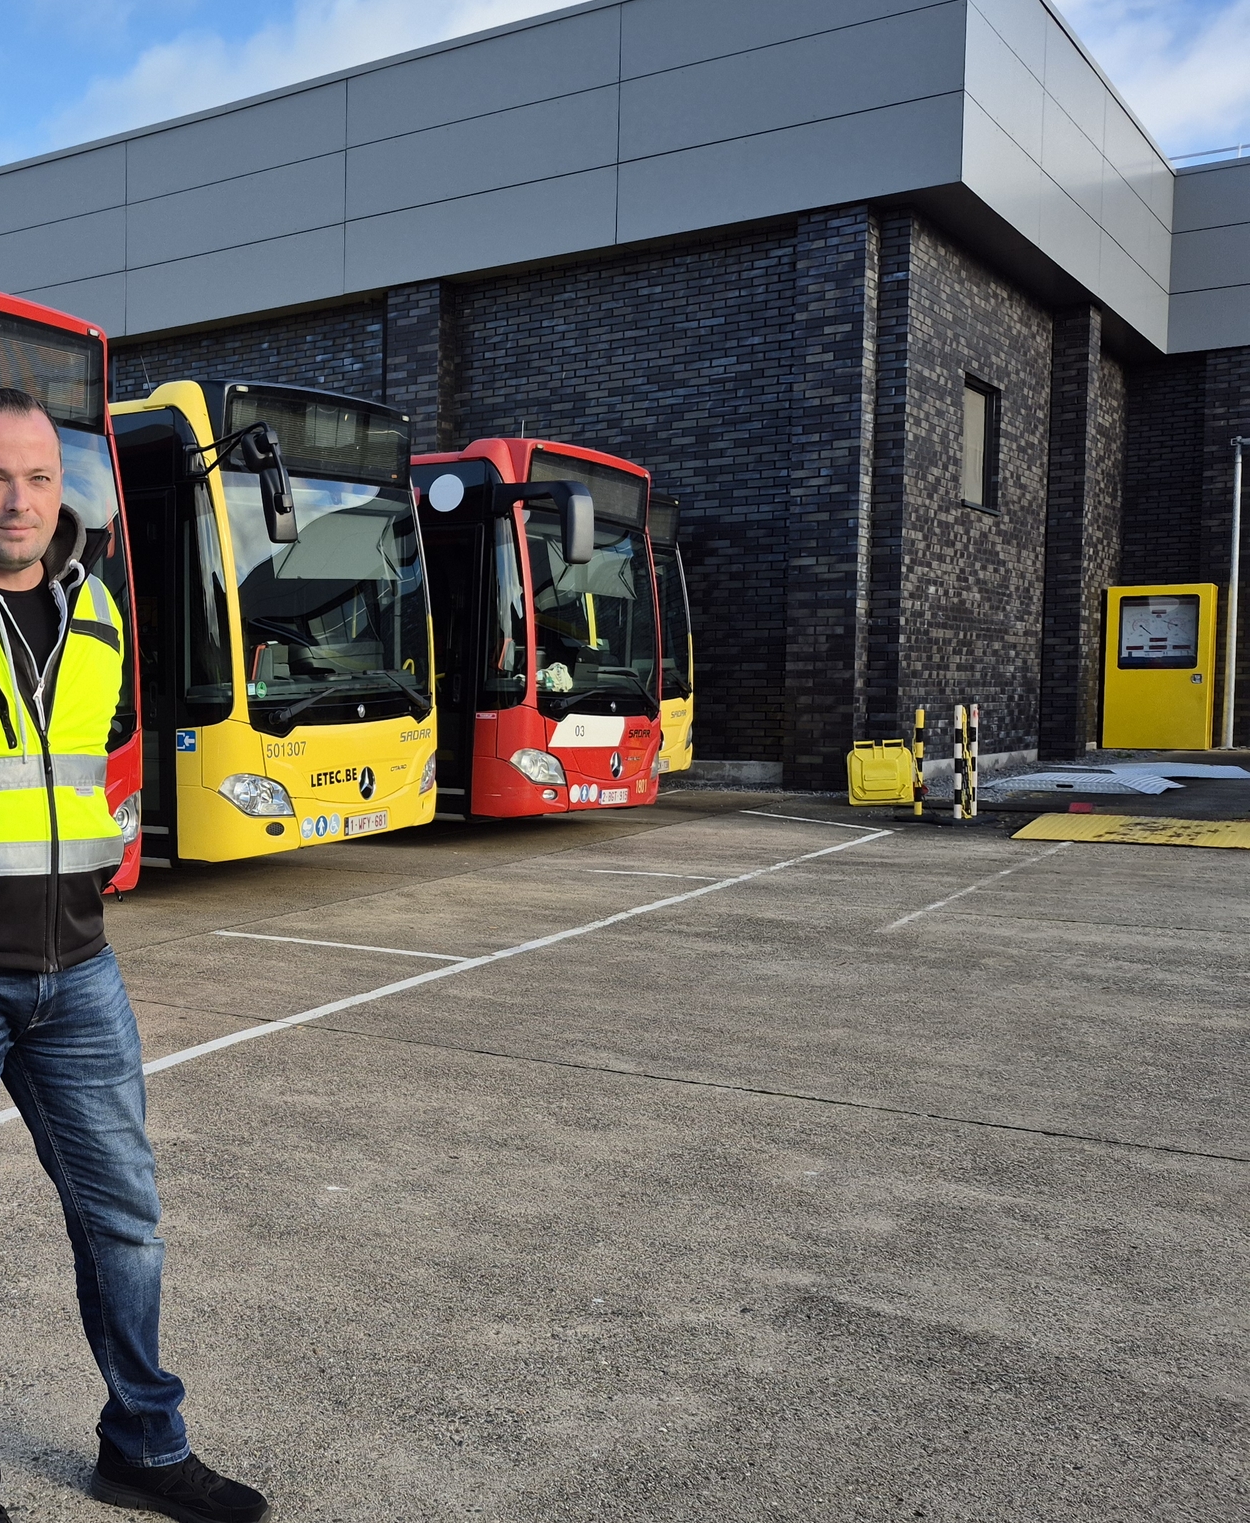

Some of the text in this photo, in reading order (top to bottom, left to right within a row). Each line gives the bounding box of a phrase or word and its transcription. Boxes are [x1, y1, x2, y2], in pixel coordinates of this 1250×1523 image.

[400, 728, 431, 742] SADAR
[575, 725, 584, 736] 03
[628, 729, 650, 738] SADAR
[266, 741, 307, 758] 501307
[311, 768, 357, 787] LETEC.BE
[635, 779, 647, 793] 1801
[350, 813, 386, 831] 1-WFY-681
